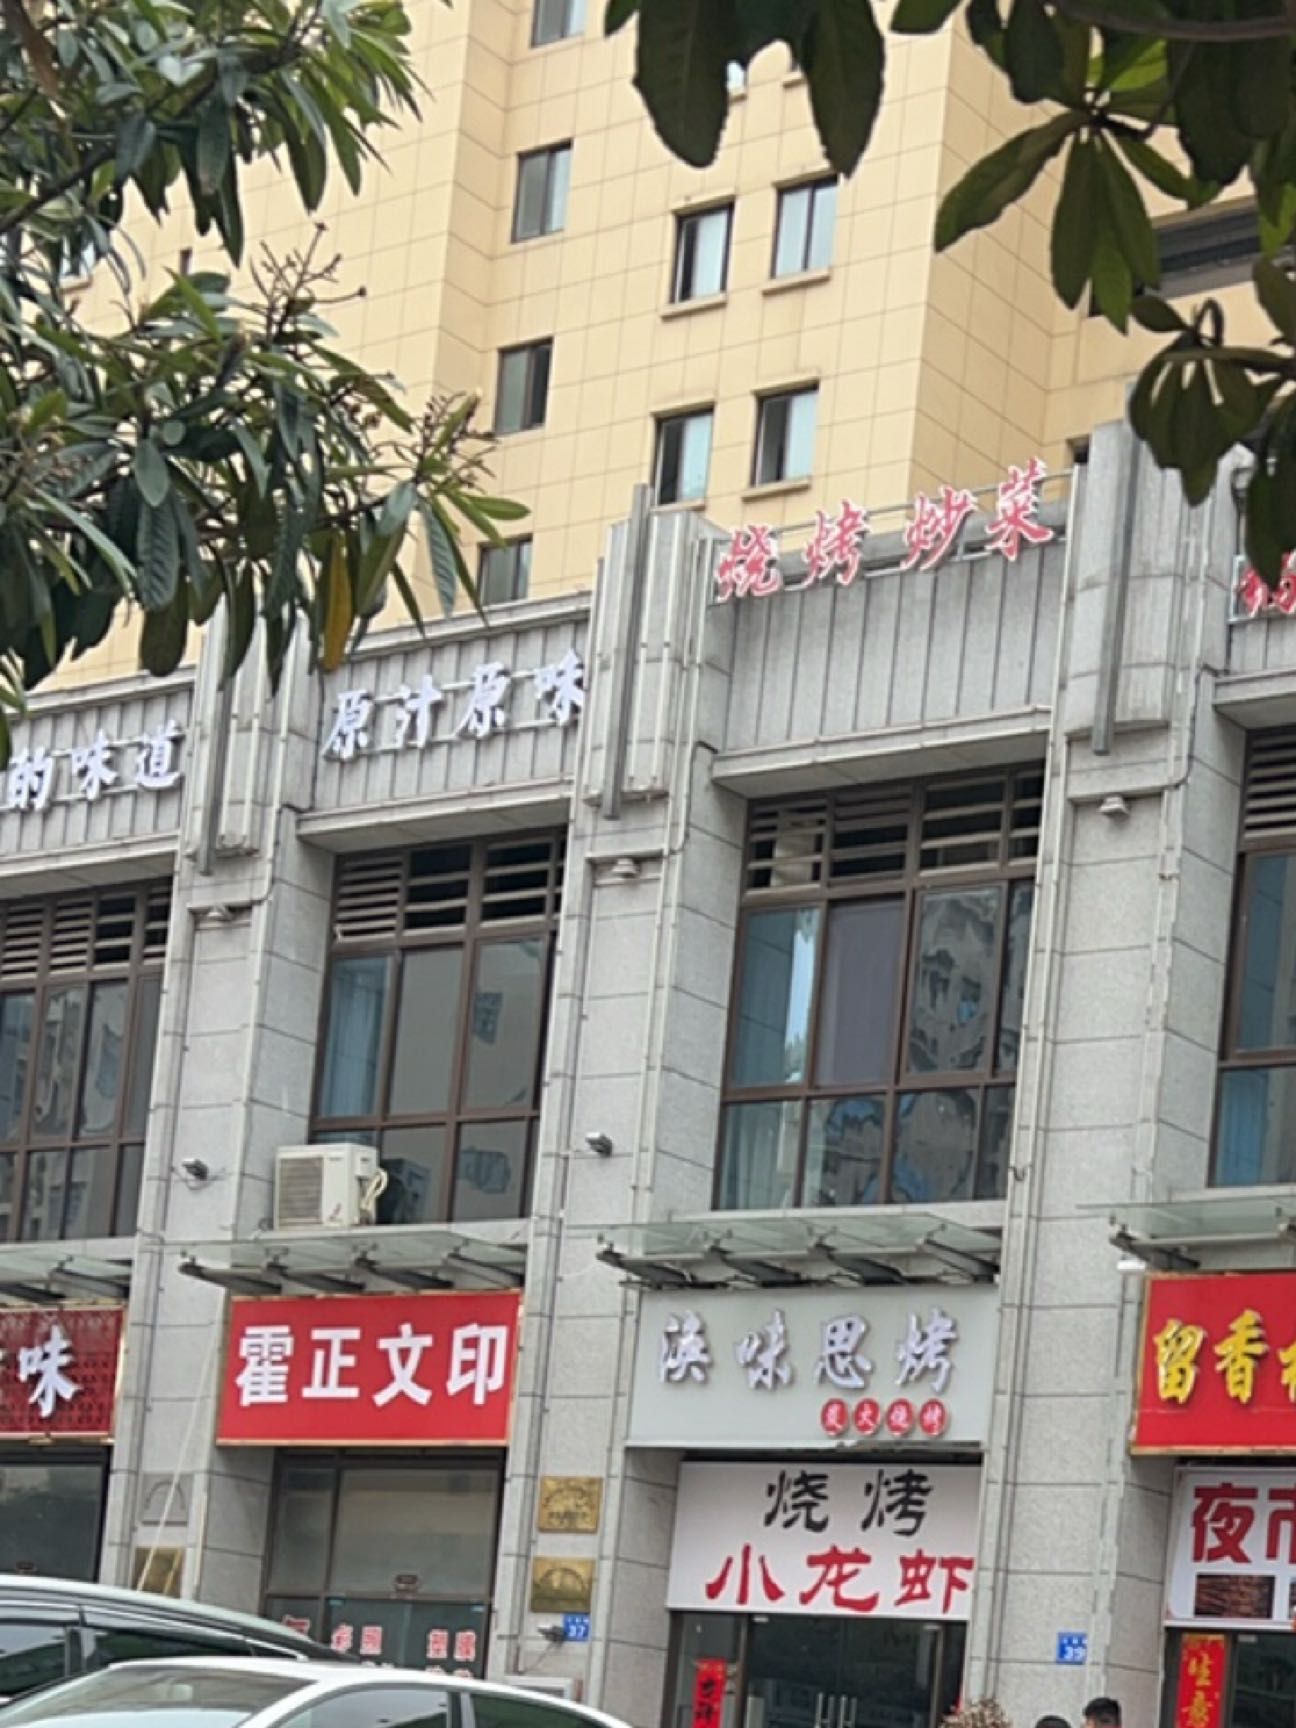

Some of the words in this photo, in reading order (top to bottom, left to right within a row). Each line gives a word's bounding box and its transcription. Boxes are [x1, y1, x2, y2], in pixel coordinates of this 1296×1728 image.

[713, 456, 1054, 602] 烧烤炒菜
[322, 648, 585, 761] 原汁原味
[8, 719, 183, 811] 的味道
[236, 1322, 509, 1406] 霍正文印
[764, 1469, 934, 1536] 烧烤
[705, 1543, 975, 1615] 小龙虾
